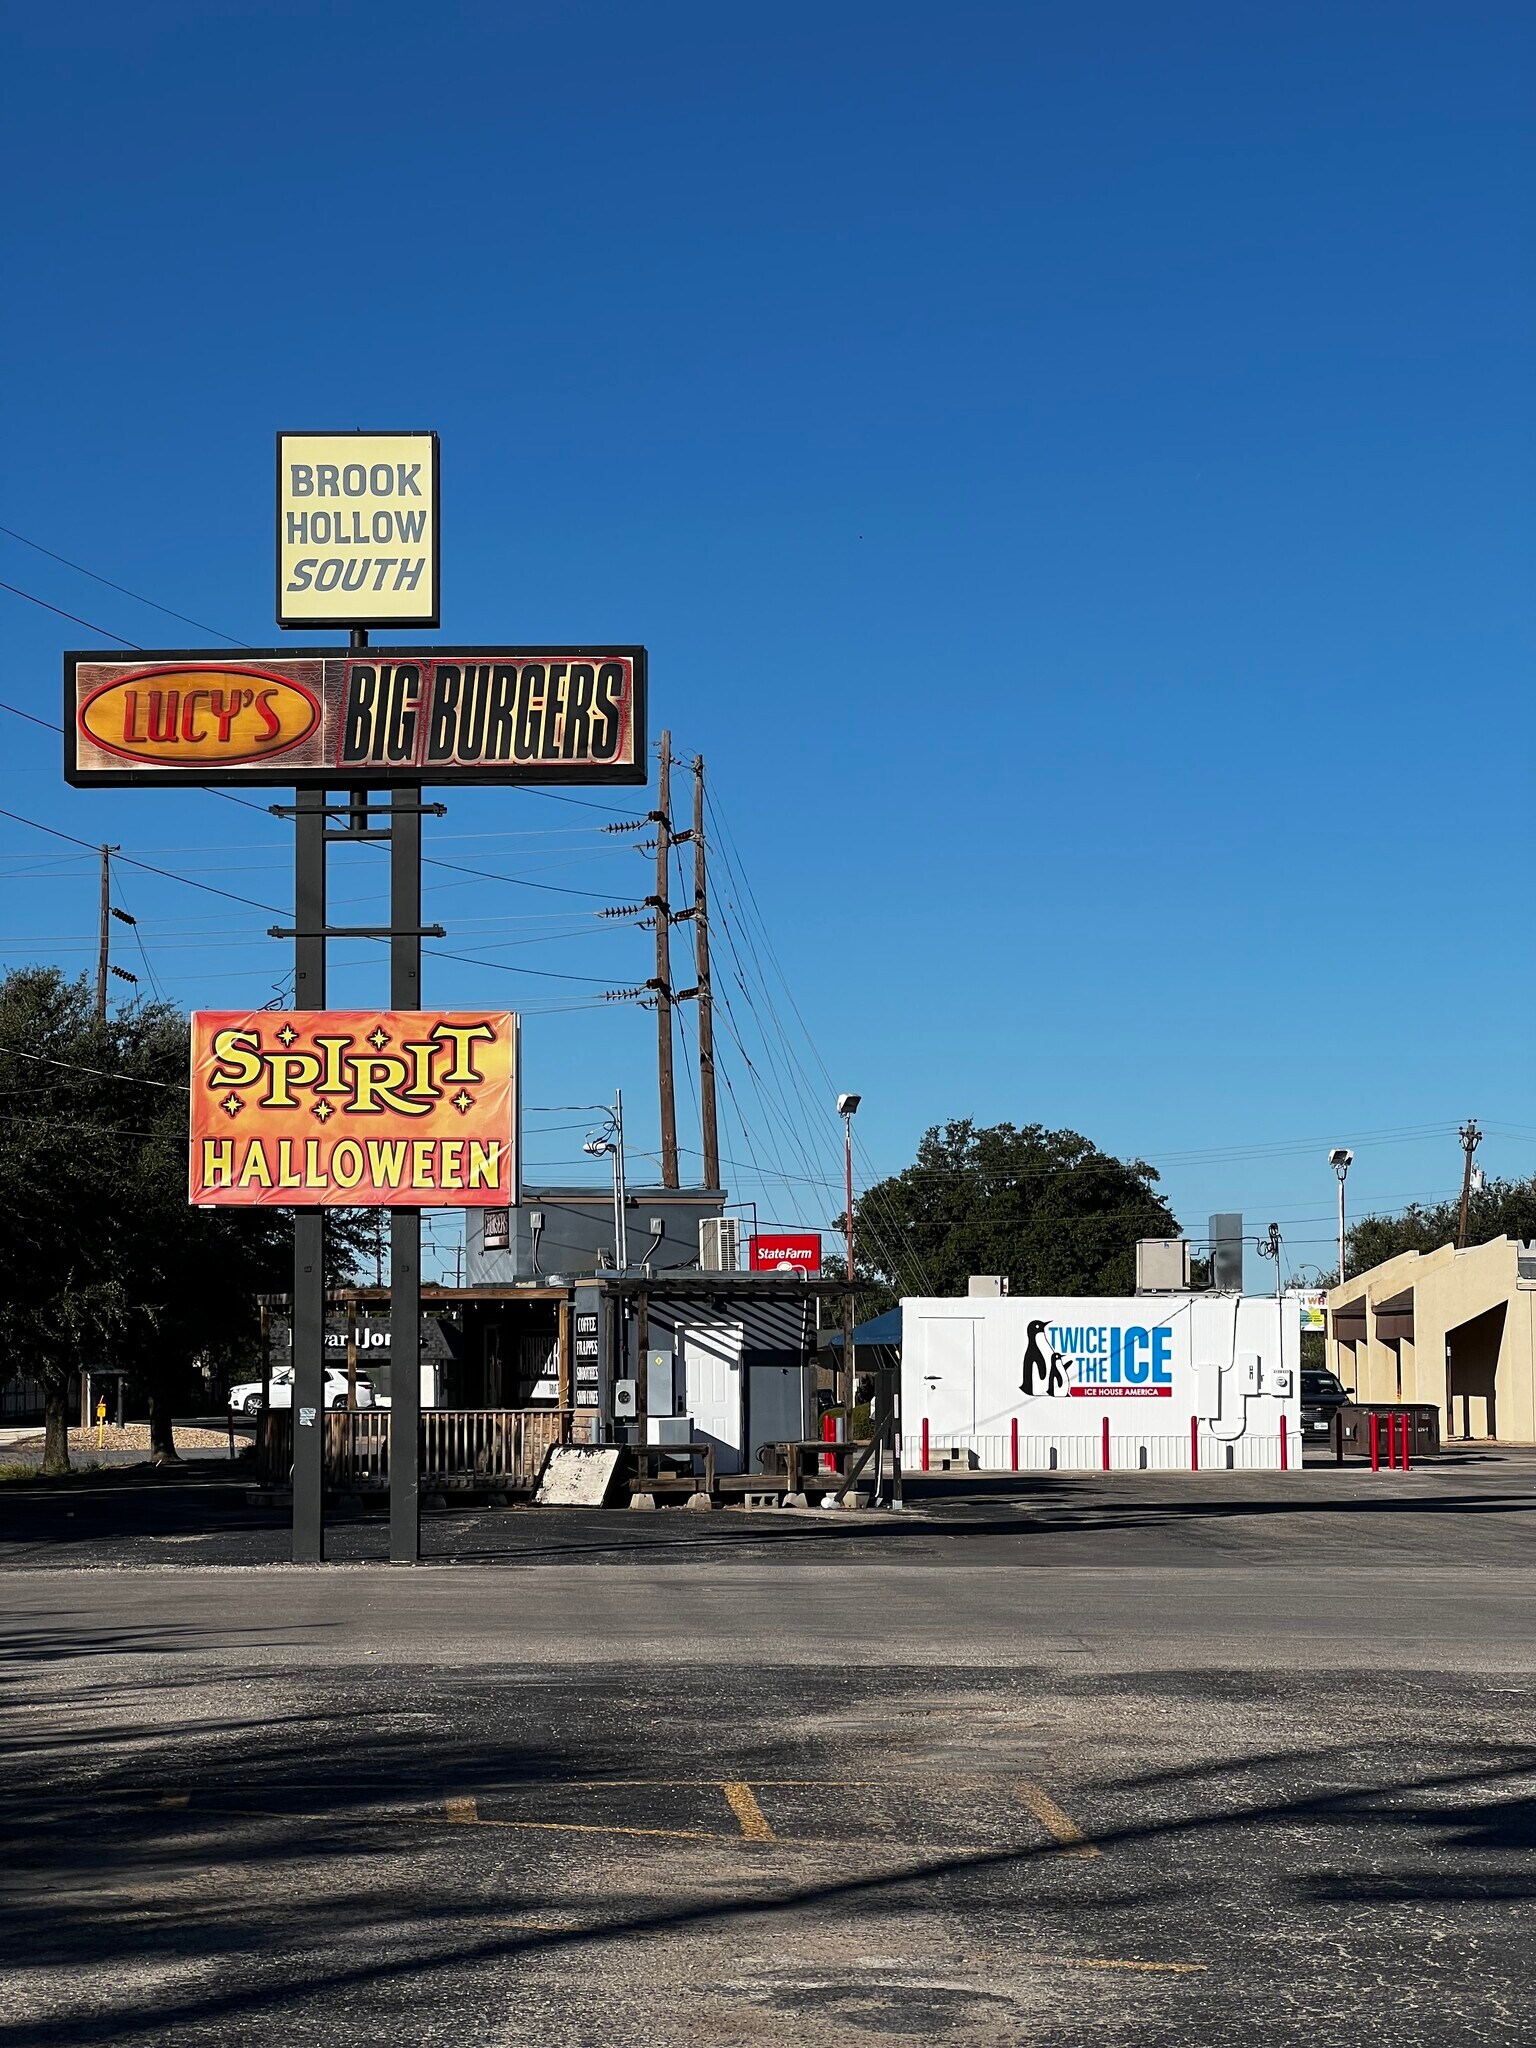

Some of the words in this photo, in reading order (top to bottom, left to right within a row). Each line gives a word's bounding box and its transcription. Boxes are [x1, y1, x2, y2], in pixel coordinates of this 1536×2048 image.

[291, 464, 422, 497] BROOK
[286, 511, 427, 544] HOLLOW
[286, 558, 426, 592] SOUTH
[123, 689, 281, 743] LUCY'S
[344, 665, 421, 763] BIG
[429, 662, 624, 761] BURGERS
[210, 1022, 497, 1115] SPIRIT
[202, 1139, 501, 1188] HALLOWEEN
[758, 1247, 785, 1259] State
[785, 1247, 812, 1259] Farm
[577, 1317, 597, 1332] COFFEE
[1048, 1327, 1107, 1353] TWICE
[576, 1341, 598, 1355] FRAPPES
[1110, 1326, 1172, 1383] ICE
[1076, 1358, 1107, 1383] THE
[1084, 1388, 1097, 1396] ICE
[1099, 1388, 1123, 1396] HOUSE
[1124, 1388, 1158, 1396] AMERICA
